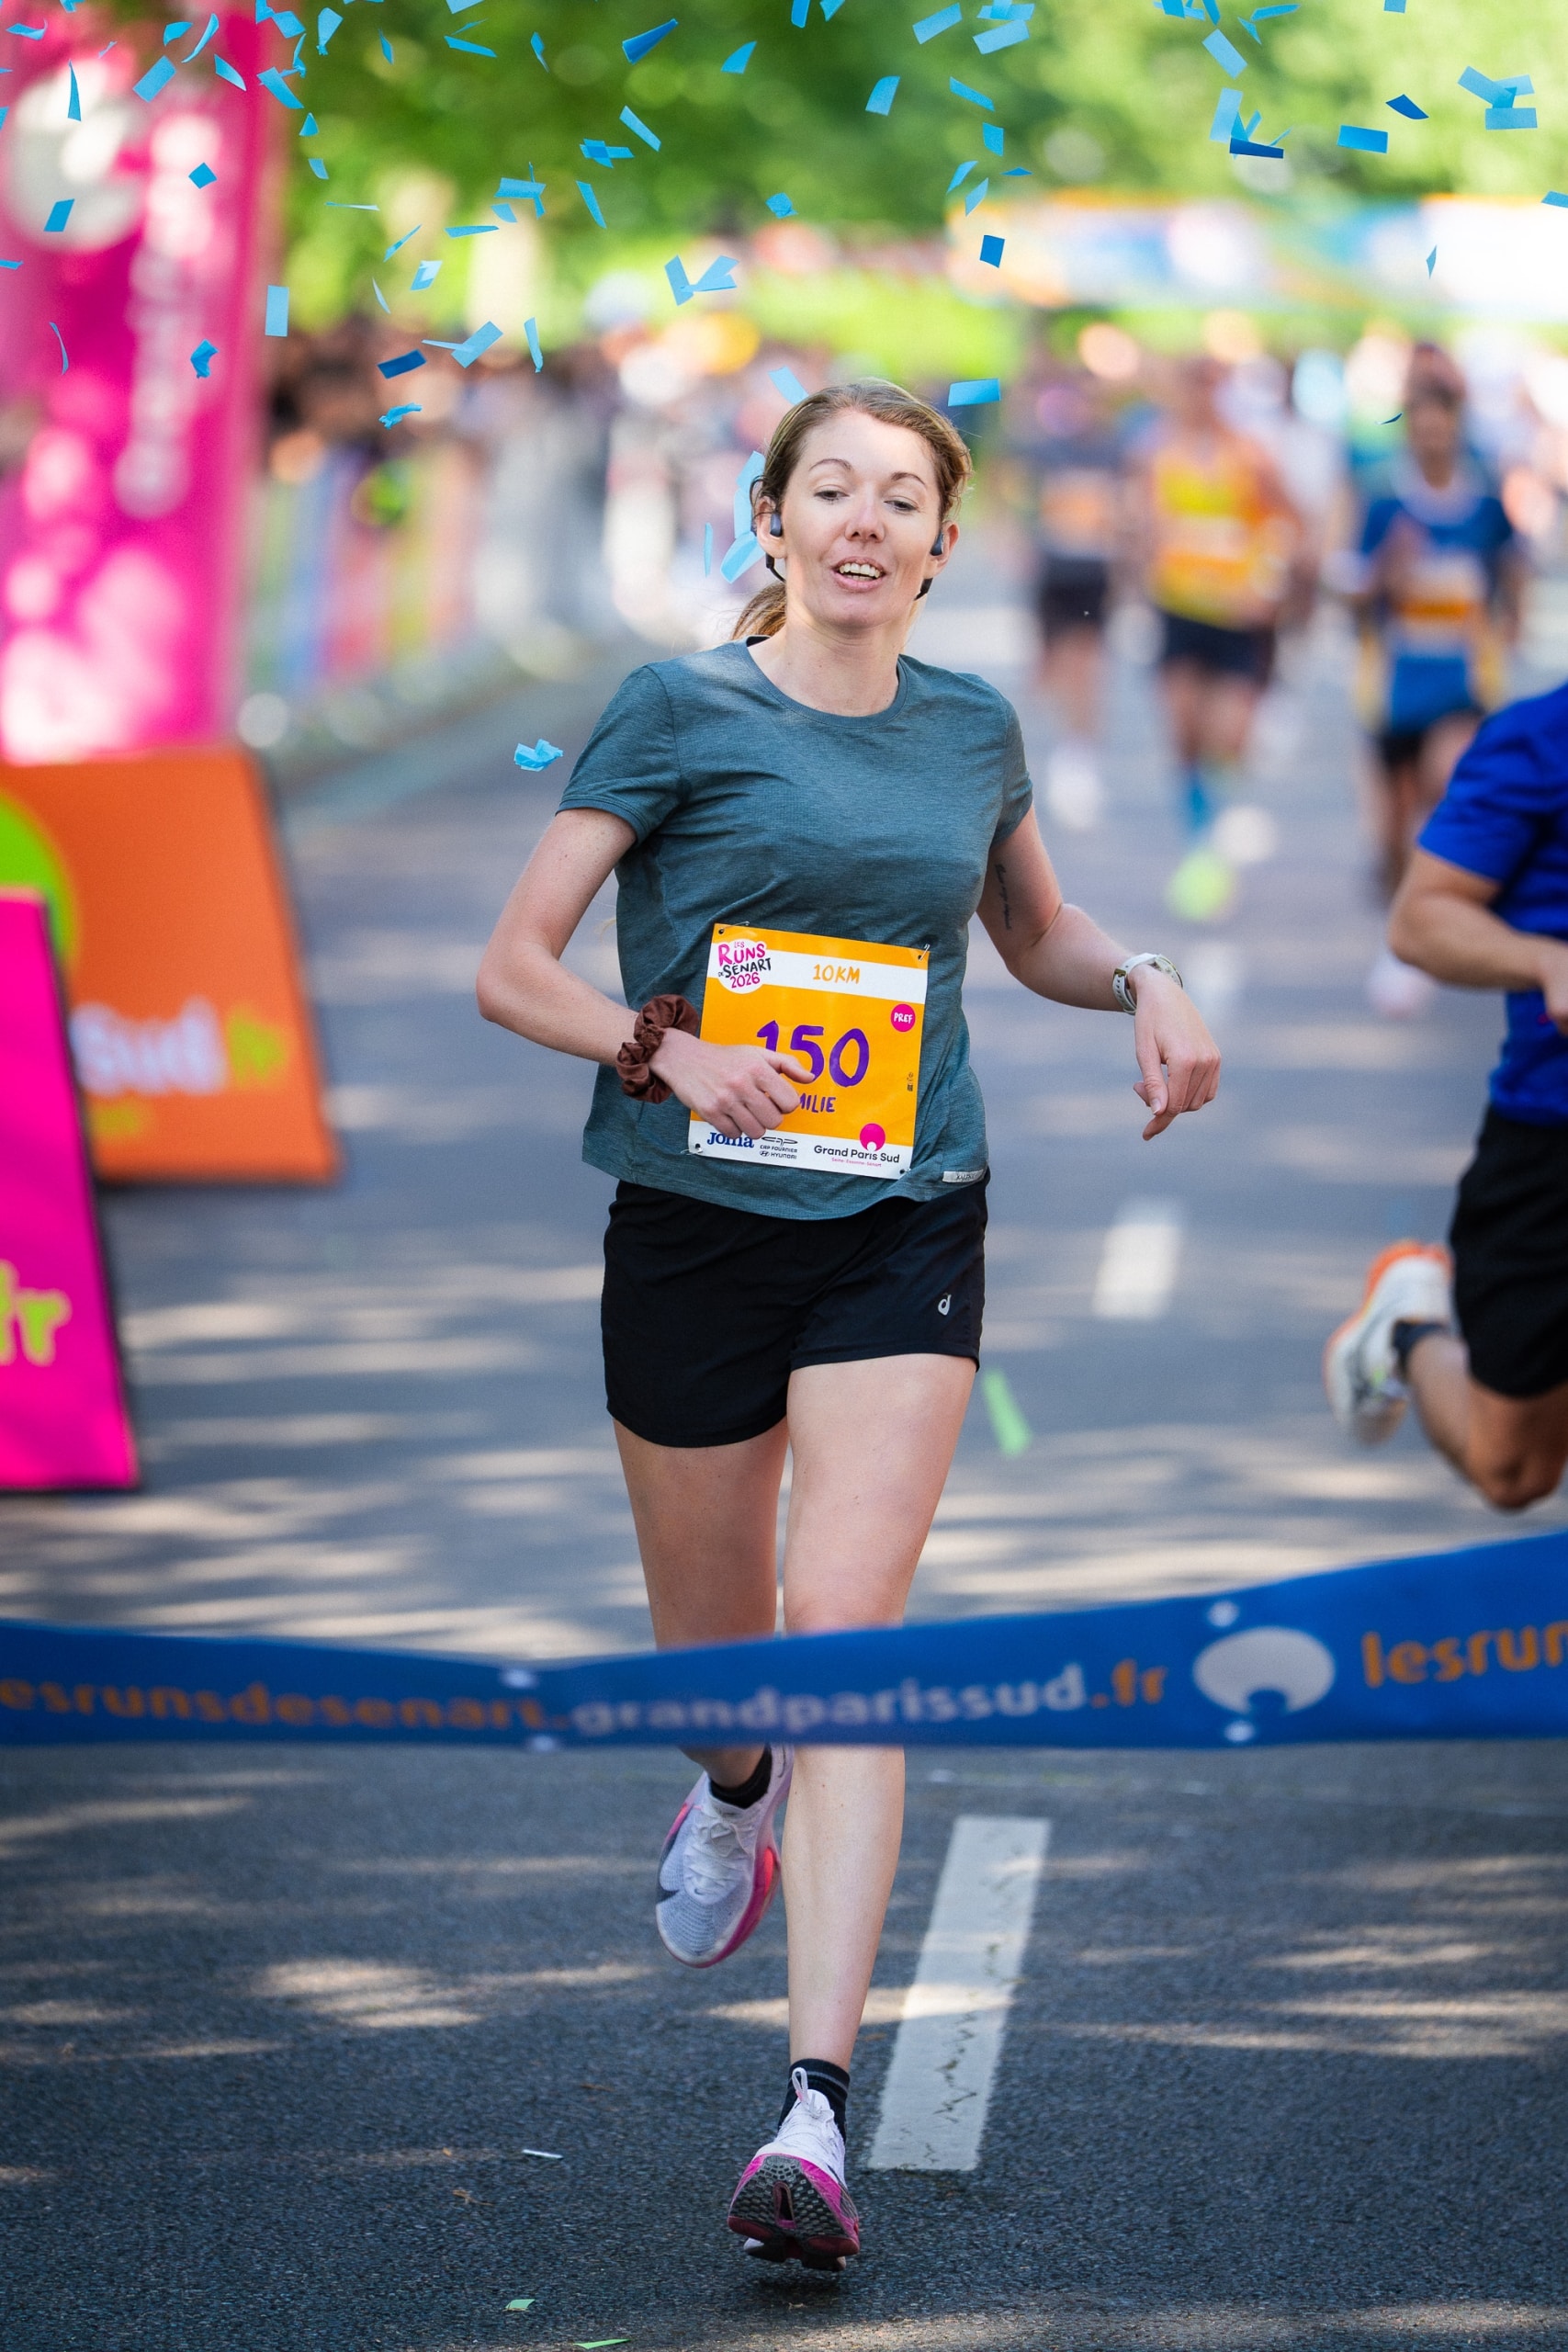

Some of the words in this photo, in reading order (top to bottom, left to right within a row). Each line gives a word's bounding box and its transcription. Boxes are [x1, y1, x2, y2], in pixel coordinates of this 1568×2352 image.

[718, 944, 766, 967] RUNS
[723, 957, 772, 978] SÉNART
[813, 964, 861, 984] 10KM
[730, 971, 761, 989] 2026
[814, 1145, 849, 1157] Grand
[851, 1148, 878, 1160] Paris
[880, 1152, 900, 1163] Sud
